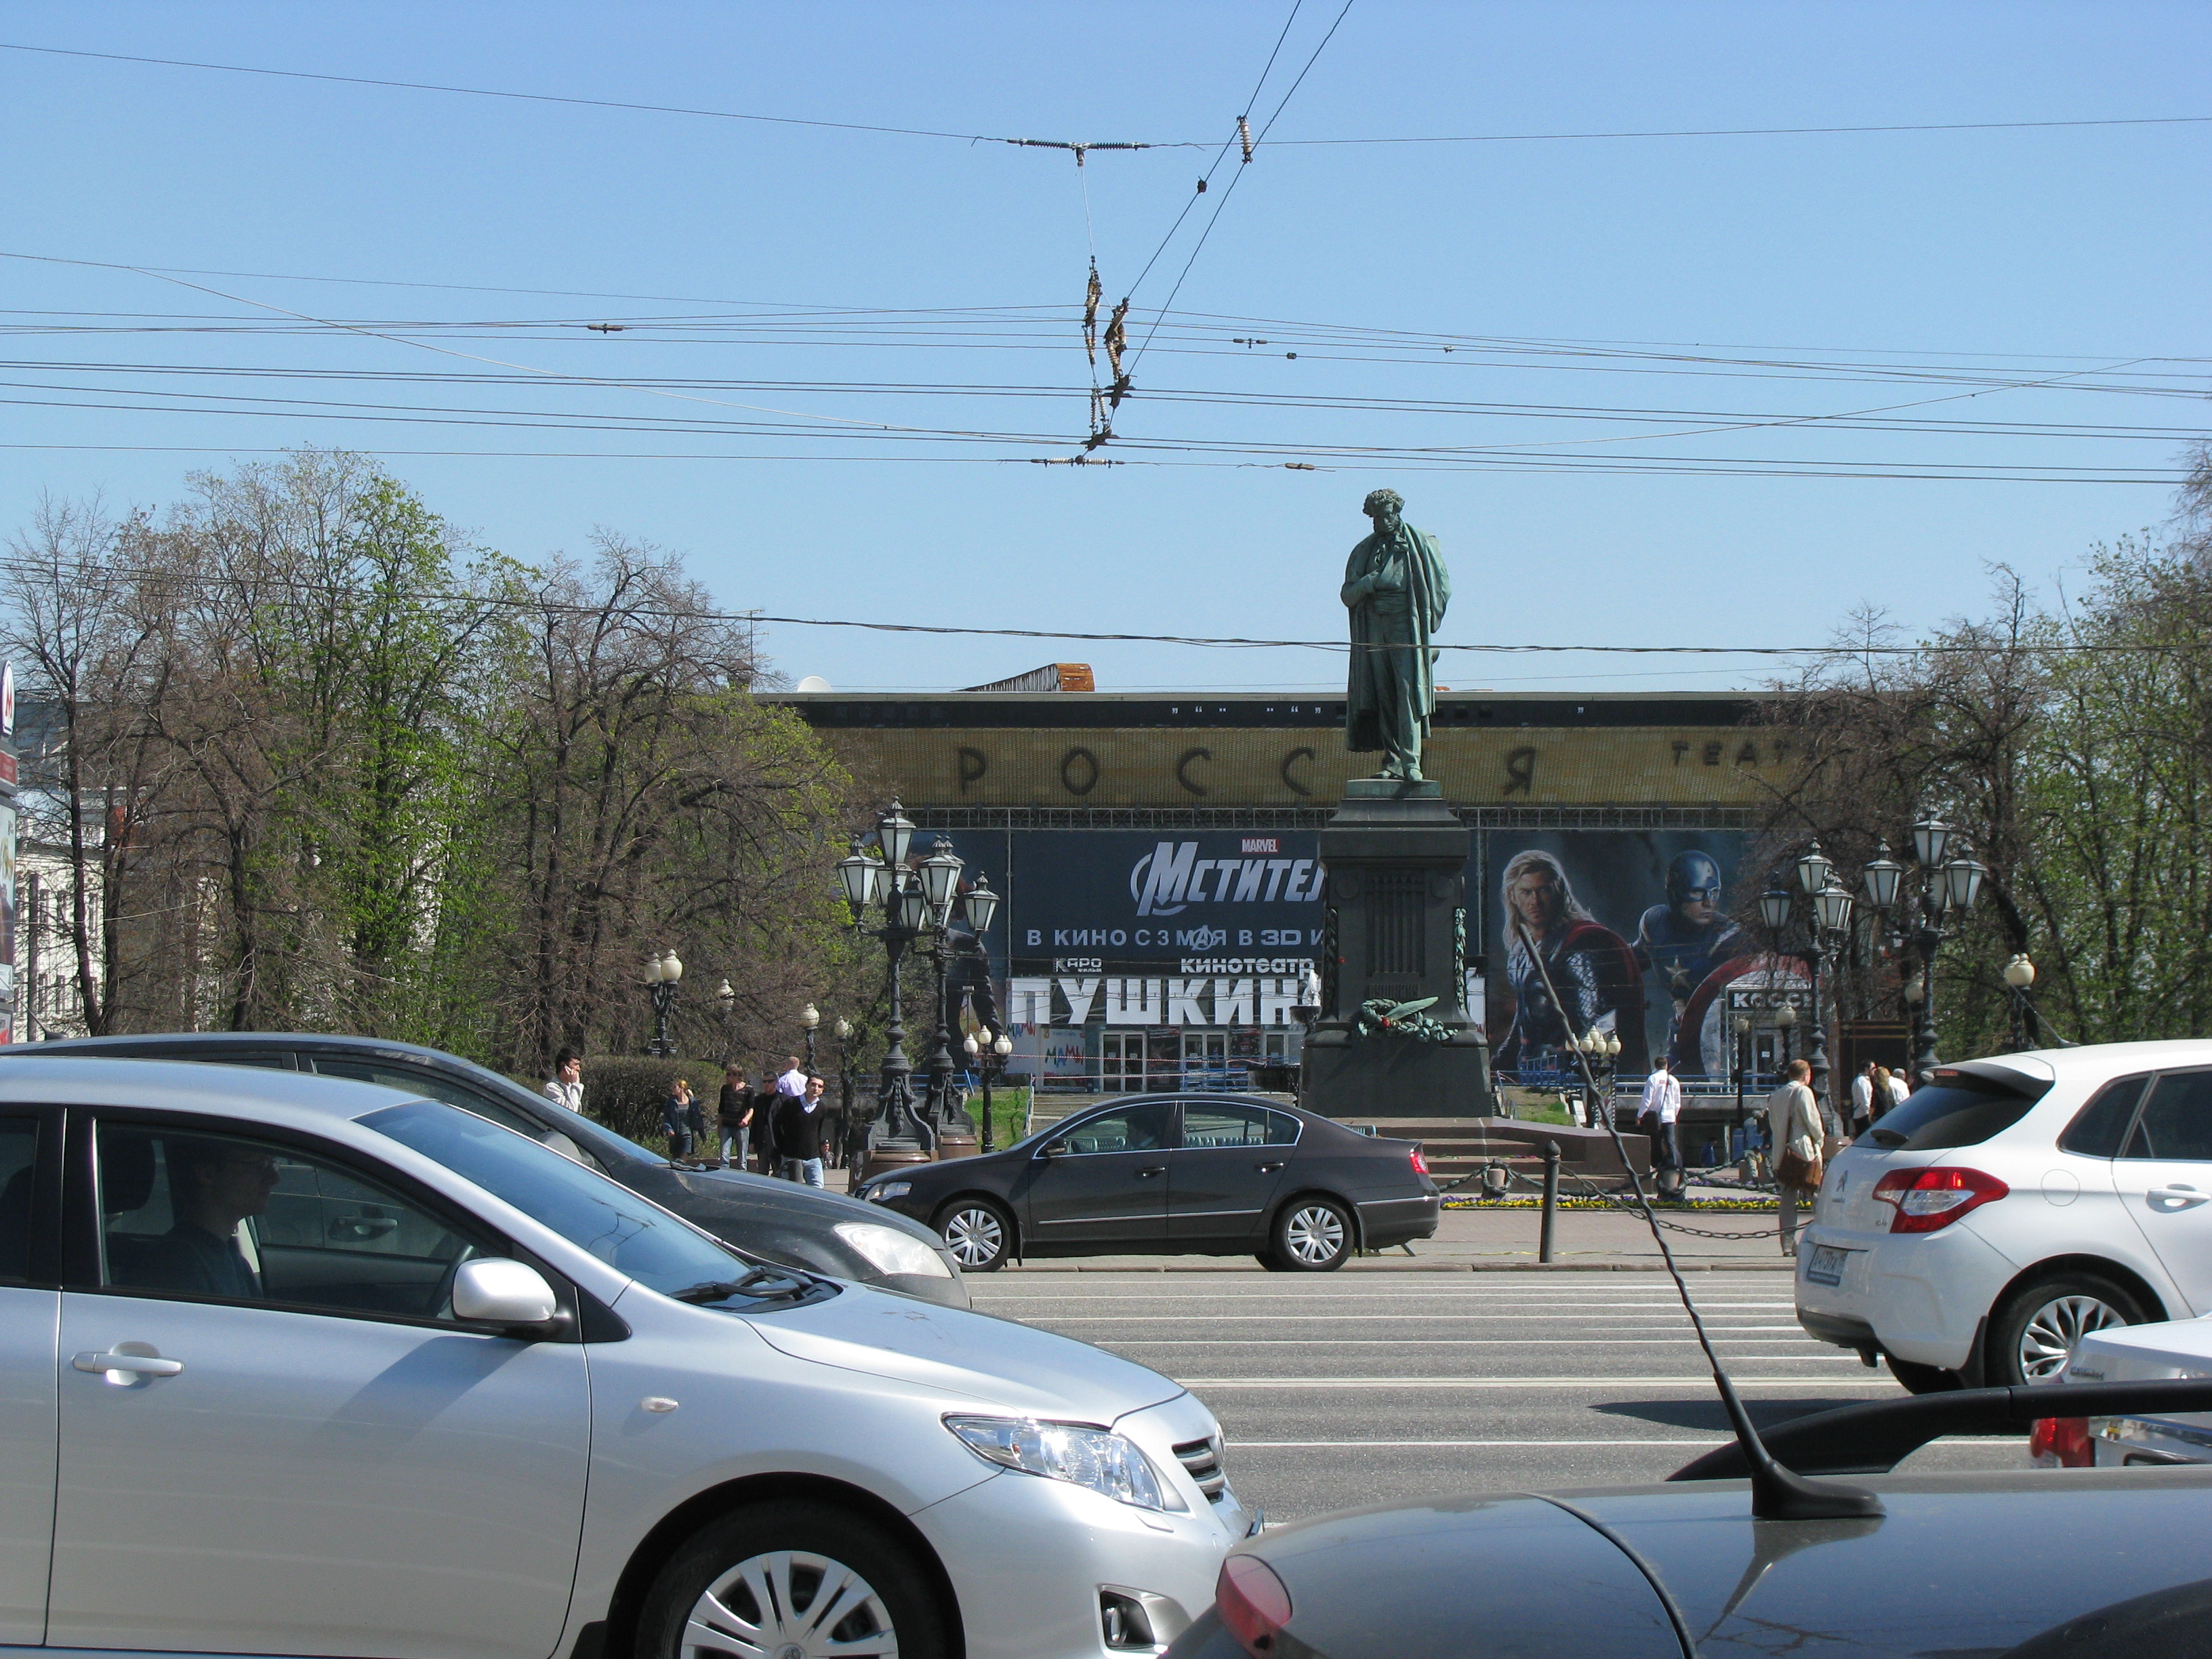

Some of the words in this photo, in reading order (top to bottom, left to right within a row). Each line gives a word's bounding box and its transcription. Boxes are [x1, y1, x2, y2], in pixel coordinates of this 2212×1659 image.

[1671, 741, 1789, 766] ТЕАТ
[959, 747, 1536, 796] РОССЯ
[1242, 839, 1277, 853] MARVEL
[1027, 929, 1042, 946] В
[1054, 929, 1127, 946] КИНО
[1134, 929, 1151, 946] С
[1158, 929, 1170, 946] 3
[1176, 924, 1227, 951] МАЯ
[1239, 929, 1253, 946] В
[1261, 929, 1302, 945] 3D
